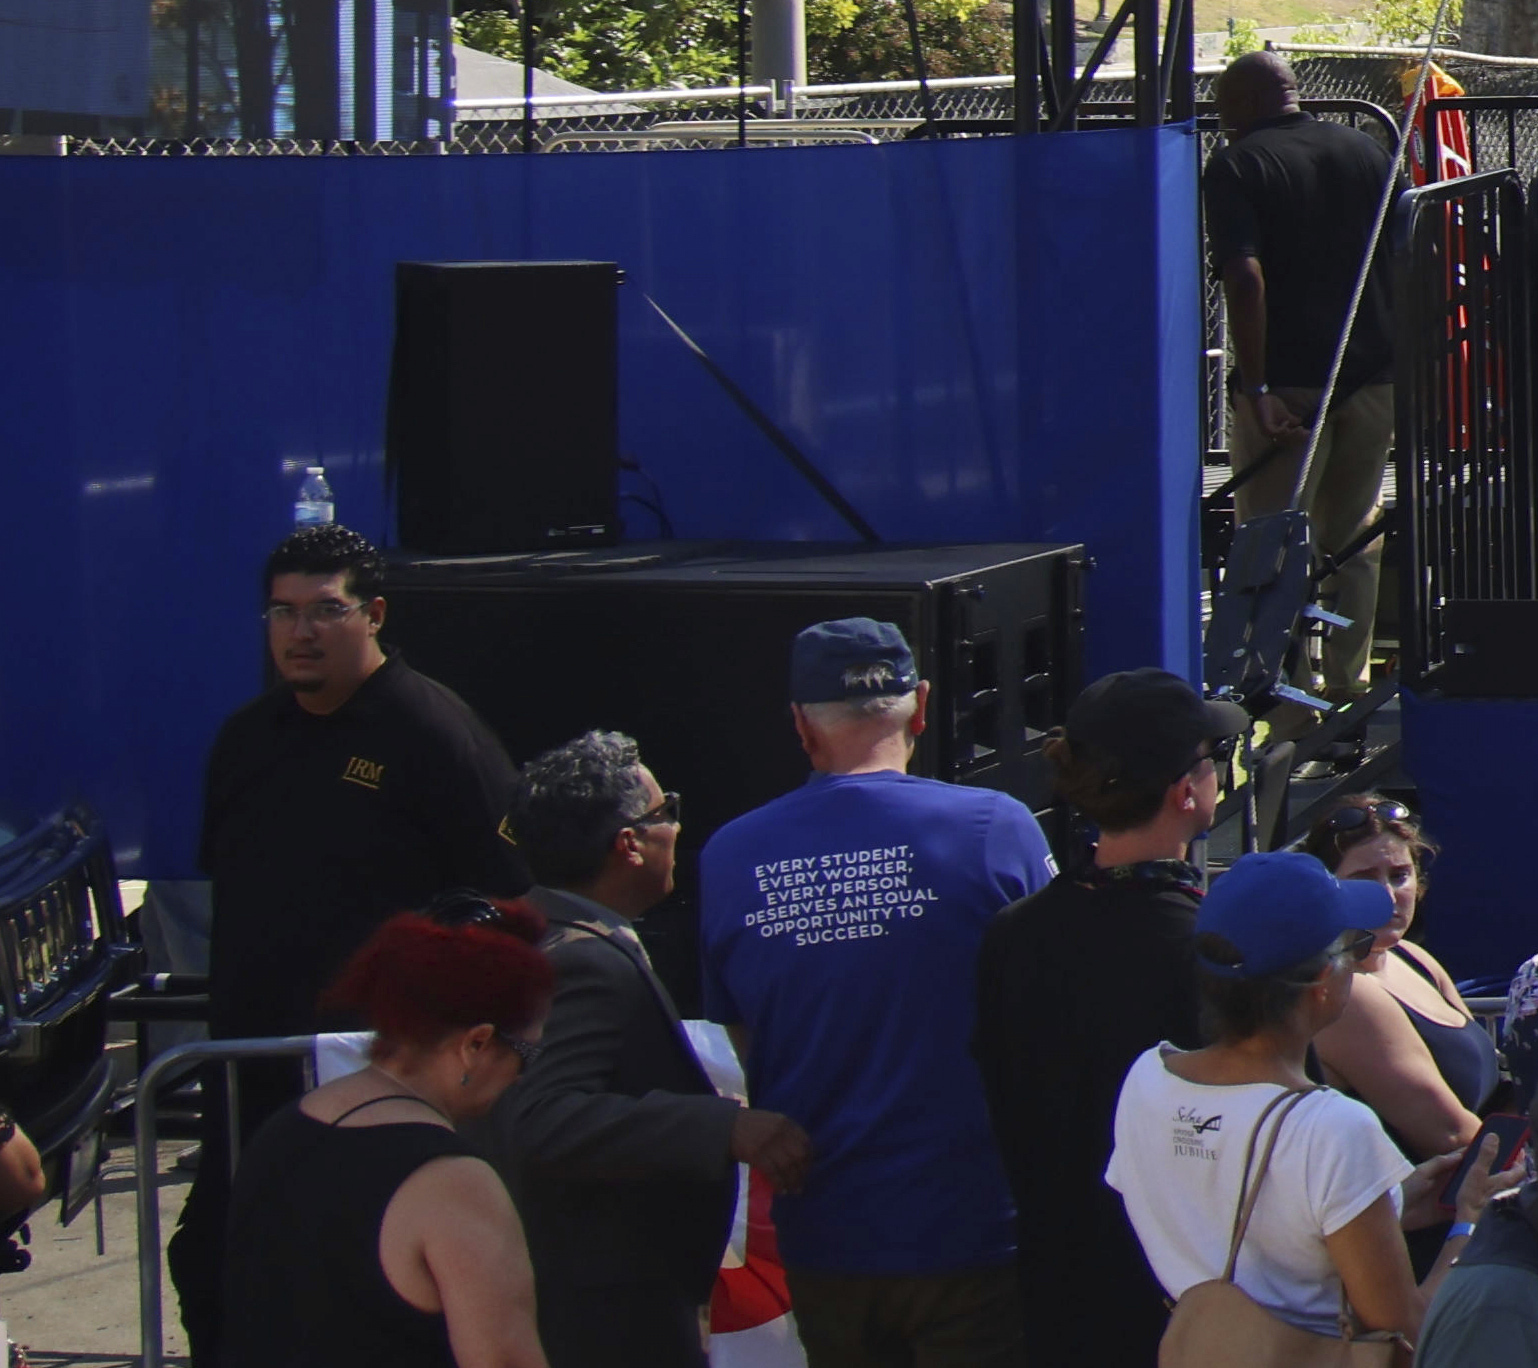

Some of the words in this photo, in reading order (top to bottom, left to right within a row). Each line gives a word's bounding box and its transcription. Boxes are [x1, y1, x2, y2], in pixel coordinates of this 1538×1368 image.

[755, 857, 816, 878] EVERY
[821, 845, 914, 868] STUDENT,
[758, 870, 819, 892] EVERY
[823, 860, 912, 881] WORKER,
[766, 884, 826, 906] EVERY
[832, 875, 908, 895] PERSON
[745, 898, 837, 926] DESERVES
[842, 895, 868, 910] AN
[873, 888, 939, 906] EQUAL
[760, 907, 893, 938] OPPORTUNITY
[897, 904, 924, 918] TO
[796, 924, 889, 947] SUCCEED.
